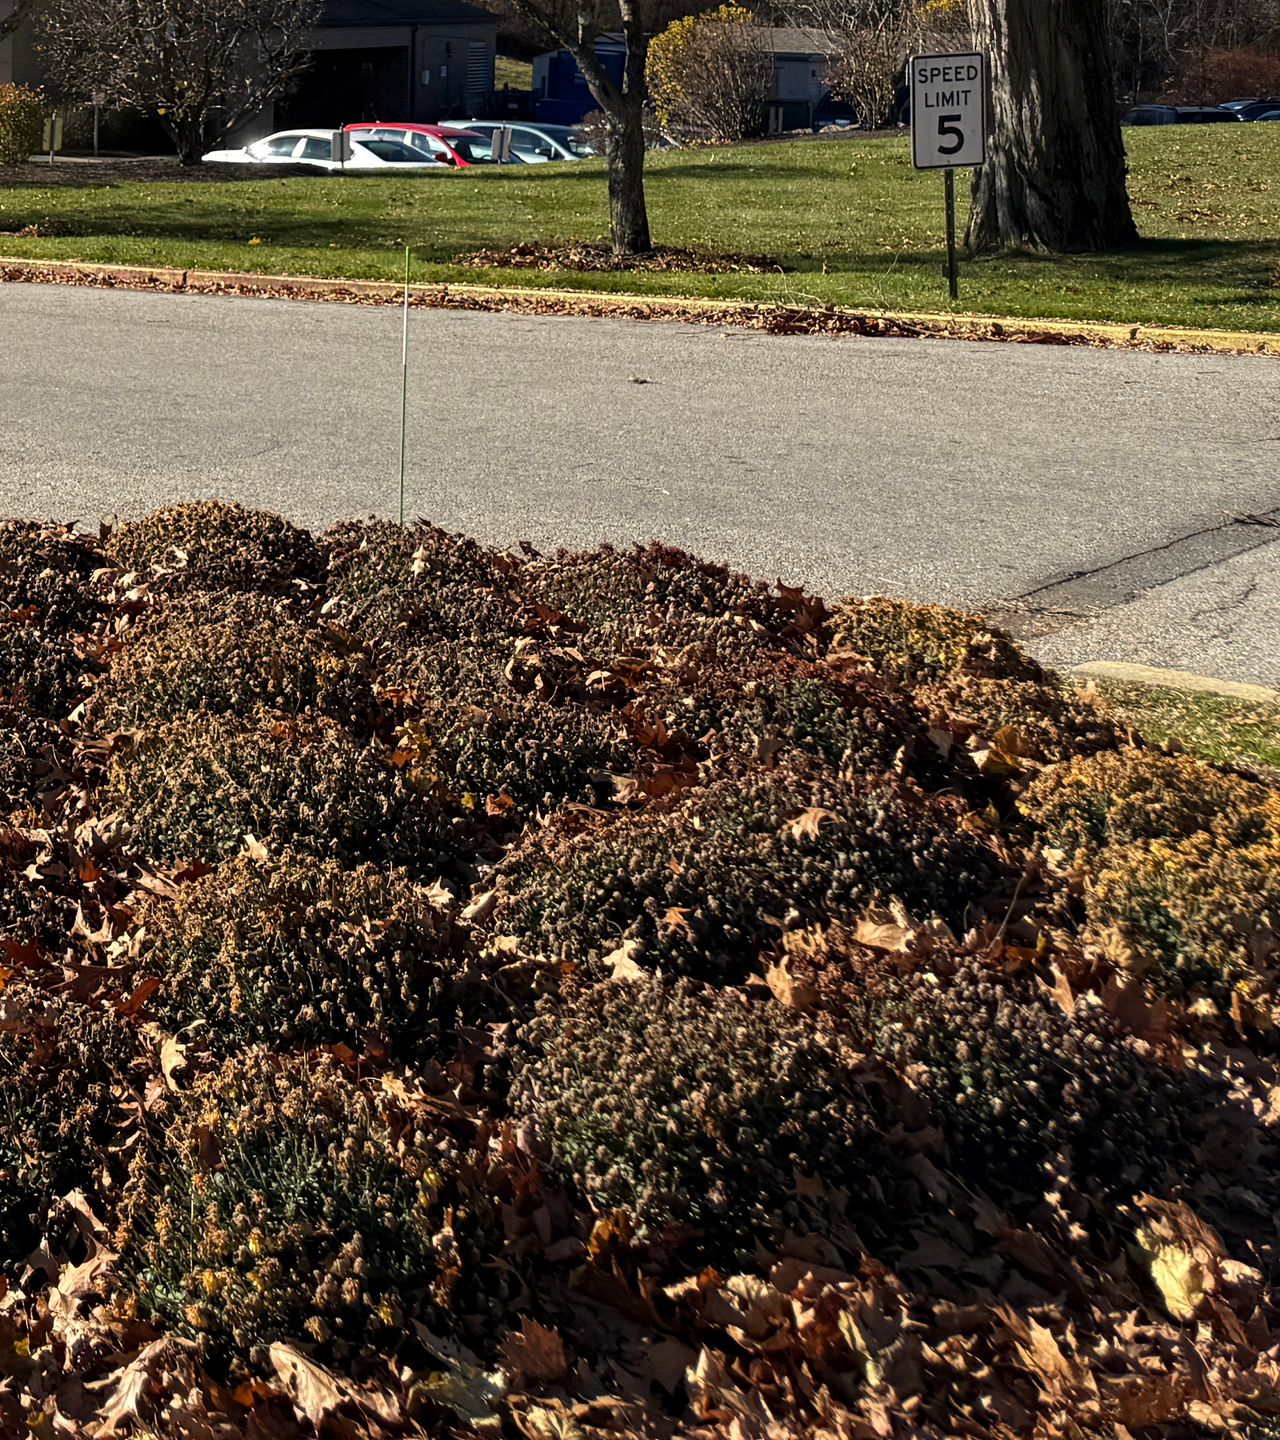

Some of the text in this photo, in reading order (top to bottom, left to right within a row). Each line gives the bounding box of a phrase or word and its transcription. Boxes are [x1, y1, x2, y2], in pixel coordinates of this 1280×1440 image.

[918, 65, 978, 83] SPEED
[924, 90, 971, 108] LIMIT
[937, 114, 965, 155] 5
